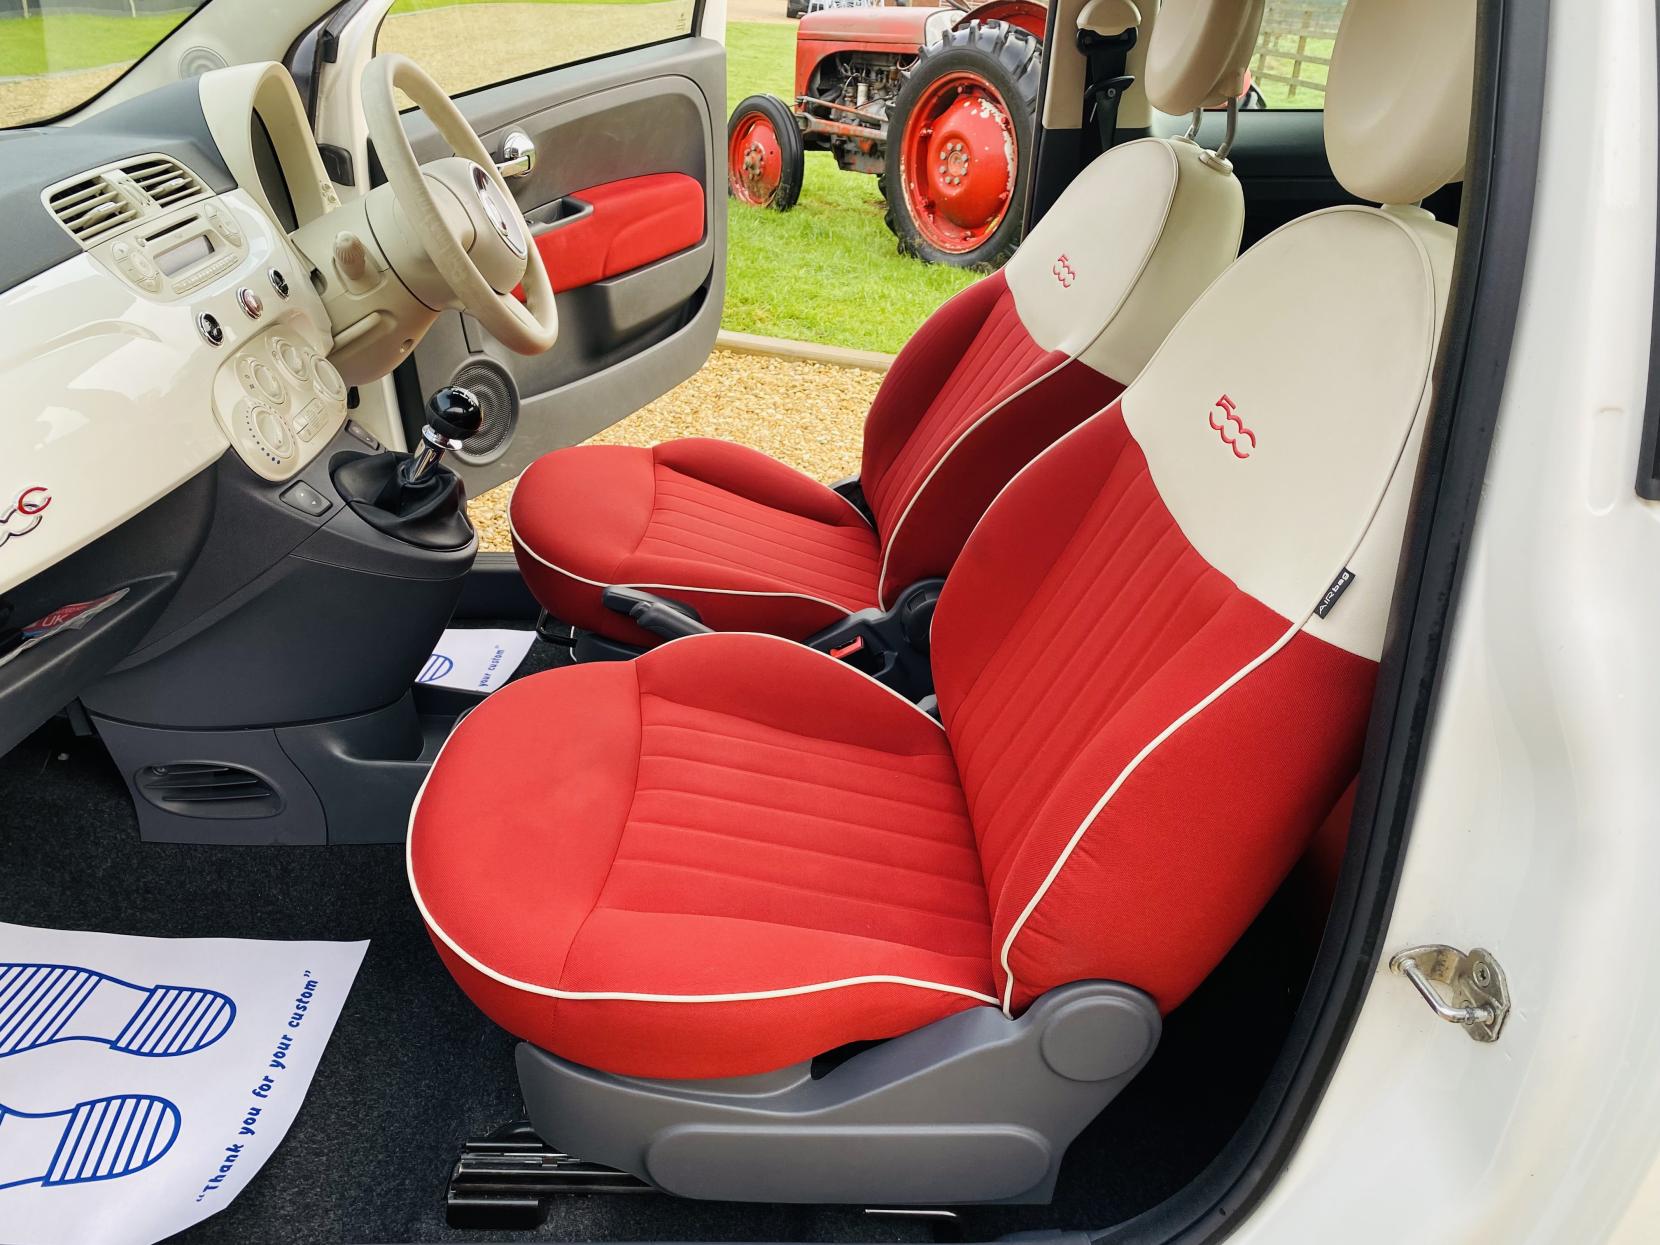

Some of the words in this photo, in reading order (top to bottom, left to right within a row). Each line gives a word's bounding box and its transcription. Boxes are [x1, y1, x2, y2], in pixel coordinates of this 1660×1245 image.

[478, 673, 492, 688] your
[238, 1106, 262, 1136] you
[252, 1075, 275, 1099] for
[269, 1034, 294, 1069] your
